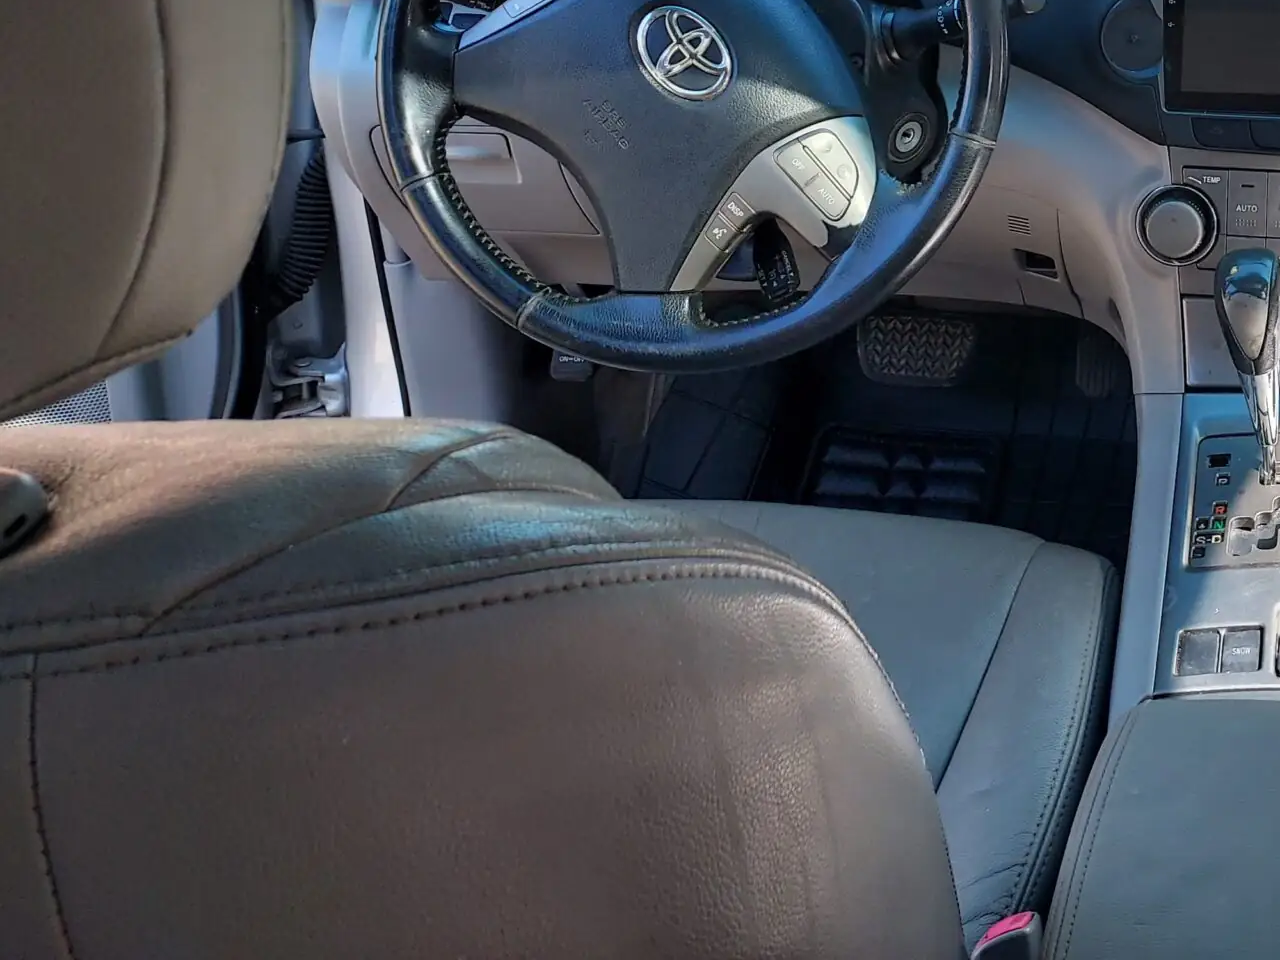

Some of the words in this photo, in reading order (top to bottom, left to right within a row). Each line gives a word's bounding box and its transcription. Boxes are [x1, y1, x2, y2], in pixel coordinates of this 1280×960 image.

[1202, 176, 1221, 184] TEMP
[818, 187, 836, 206] AUTO
[727, 201, 745, 218] DISP
[1235, 204, 1258, 213] AUTO
